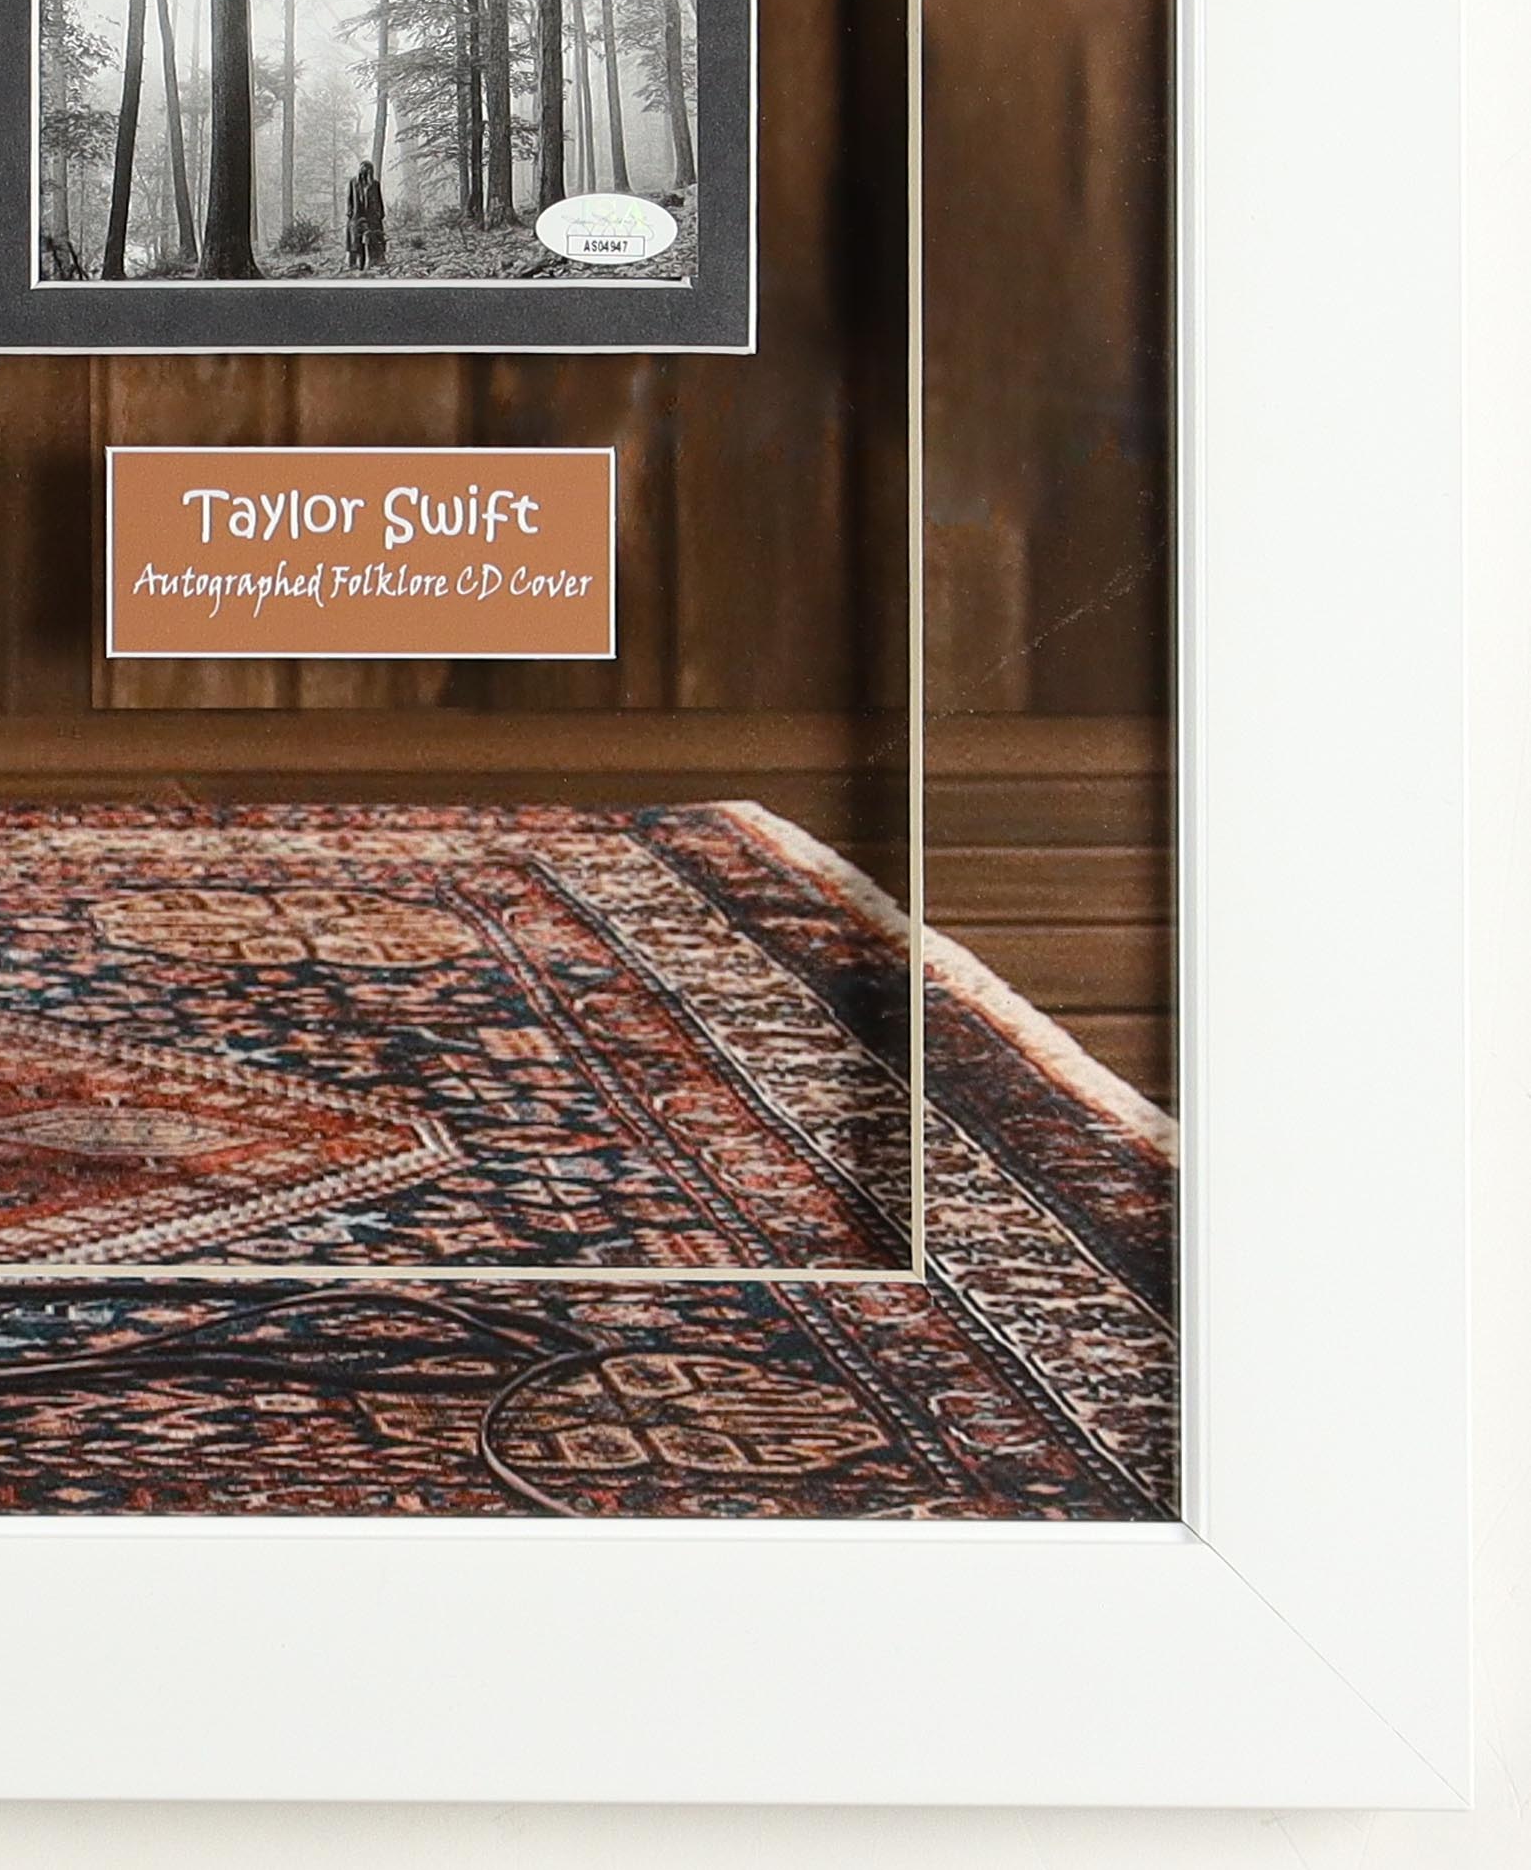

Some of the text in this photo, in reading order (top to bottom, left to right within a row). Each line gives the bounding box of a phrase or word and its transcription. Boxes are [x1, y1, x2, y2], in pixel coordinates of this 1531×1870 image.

[583, 240, 628, 253] AS04947
[182, 484, 539, 550] Taylor Swift
[132, 560, 593, 618] Autographed Folklore CD Cover
